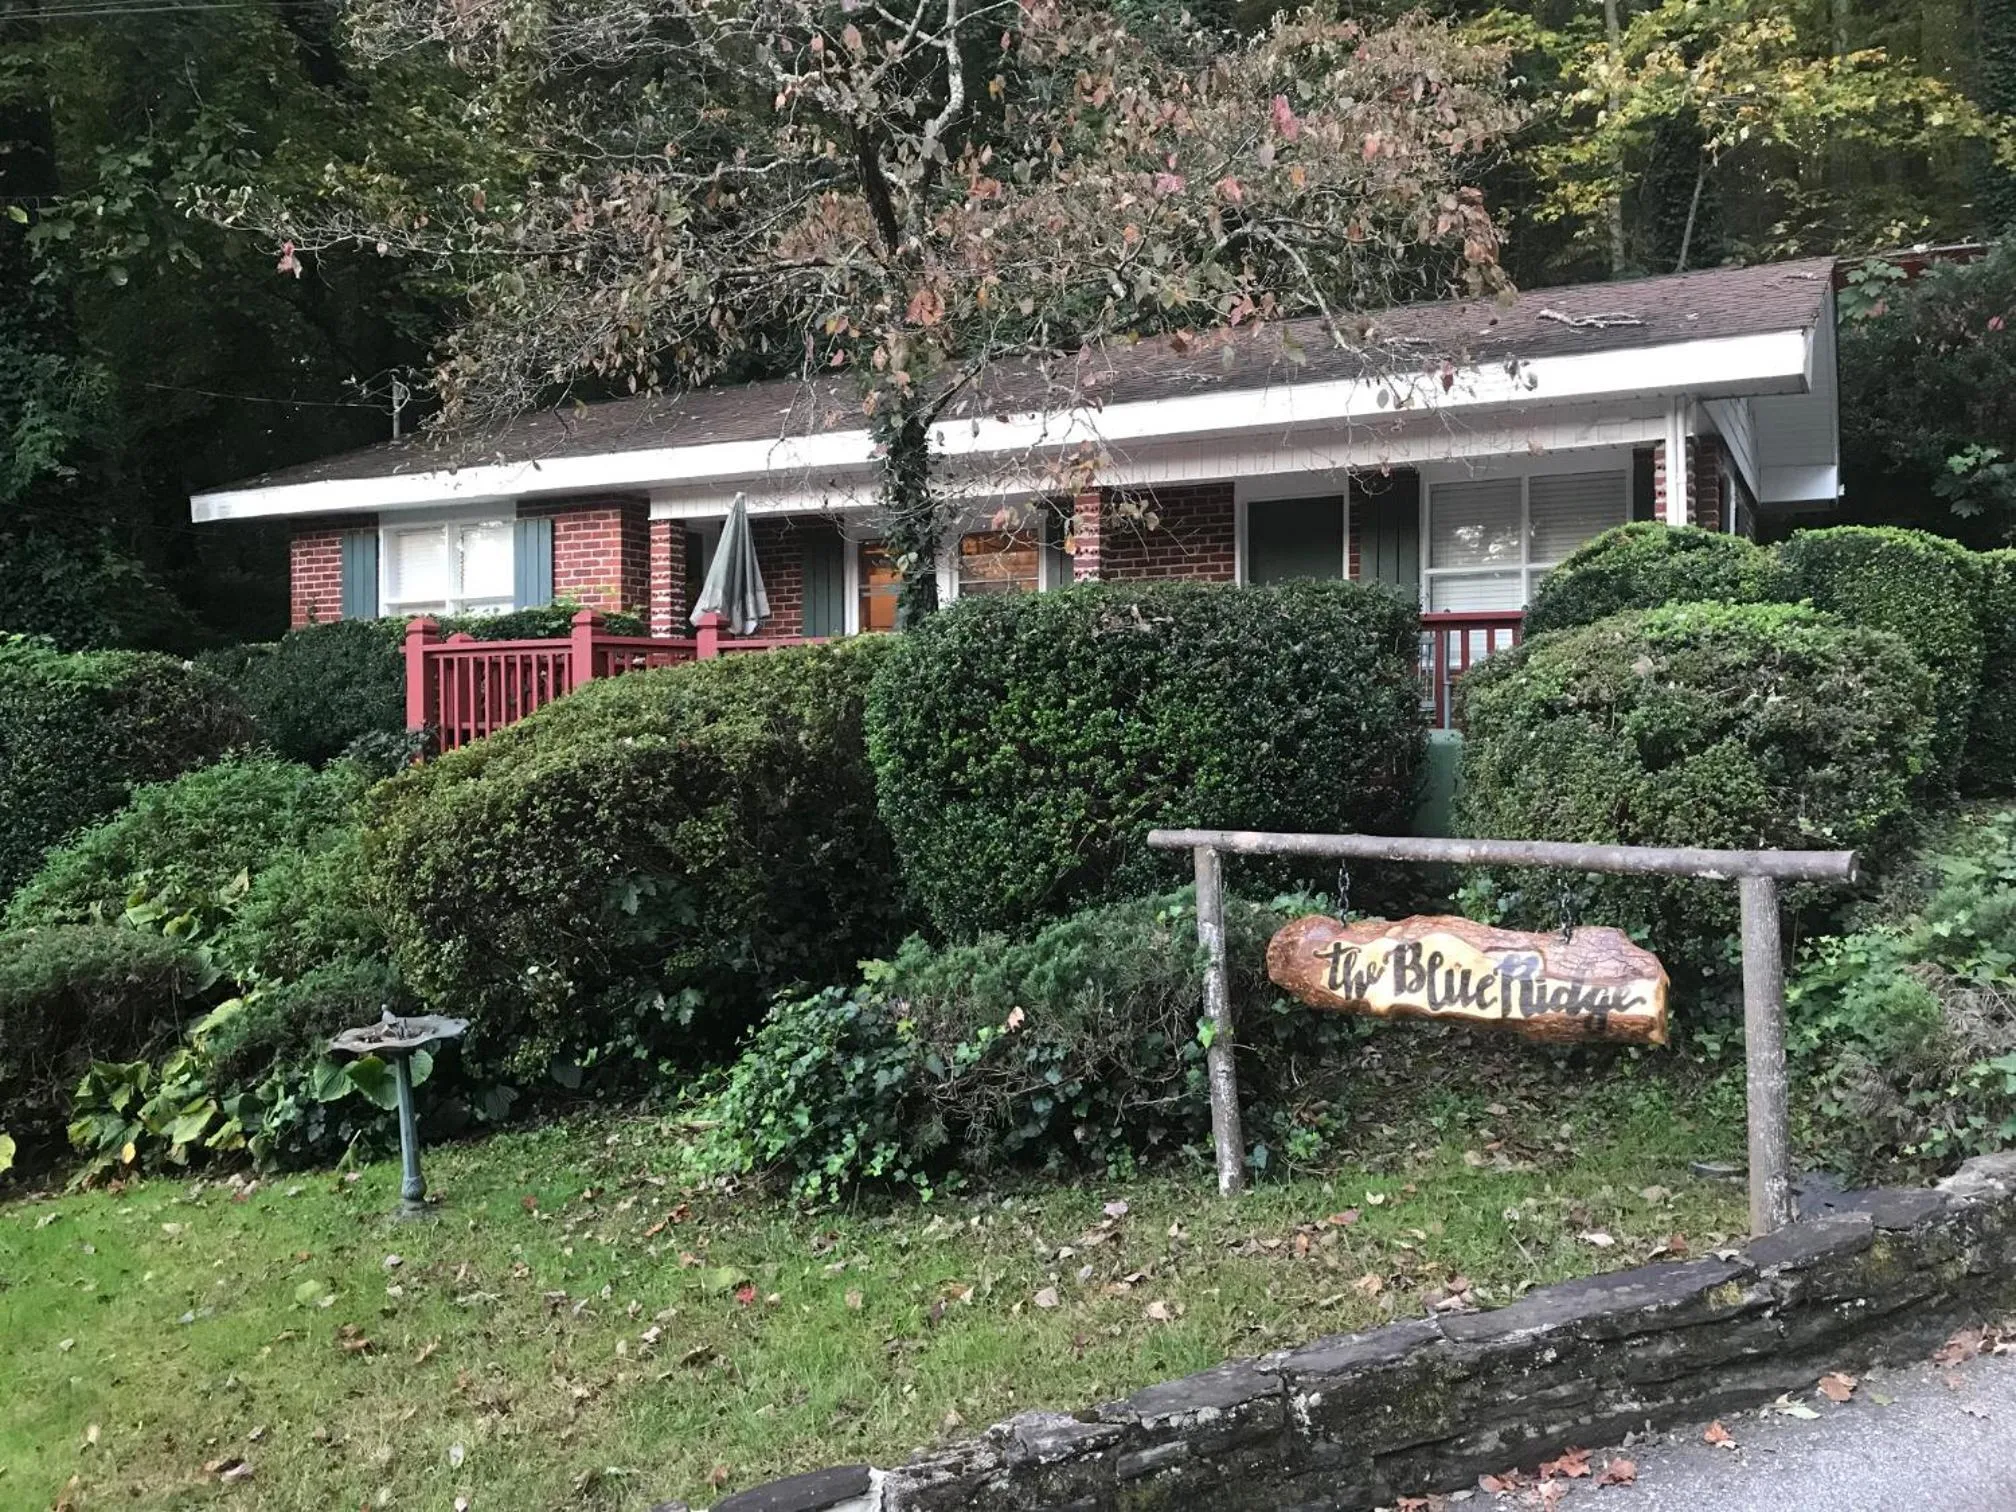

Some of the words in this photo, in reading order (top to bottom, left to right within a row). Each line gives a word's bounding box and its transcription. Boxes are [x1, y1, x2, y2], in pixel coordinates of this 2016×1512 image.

[1314, 942, 1386, 1000] the
[1385, 943, 1498, 1011] Blue
[1494, 954, 1647, 1033] Ridge
